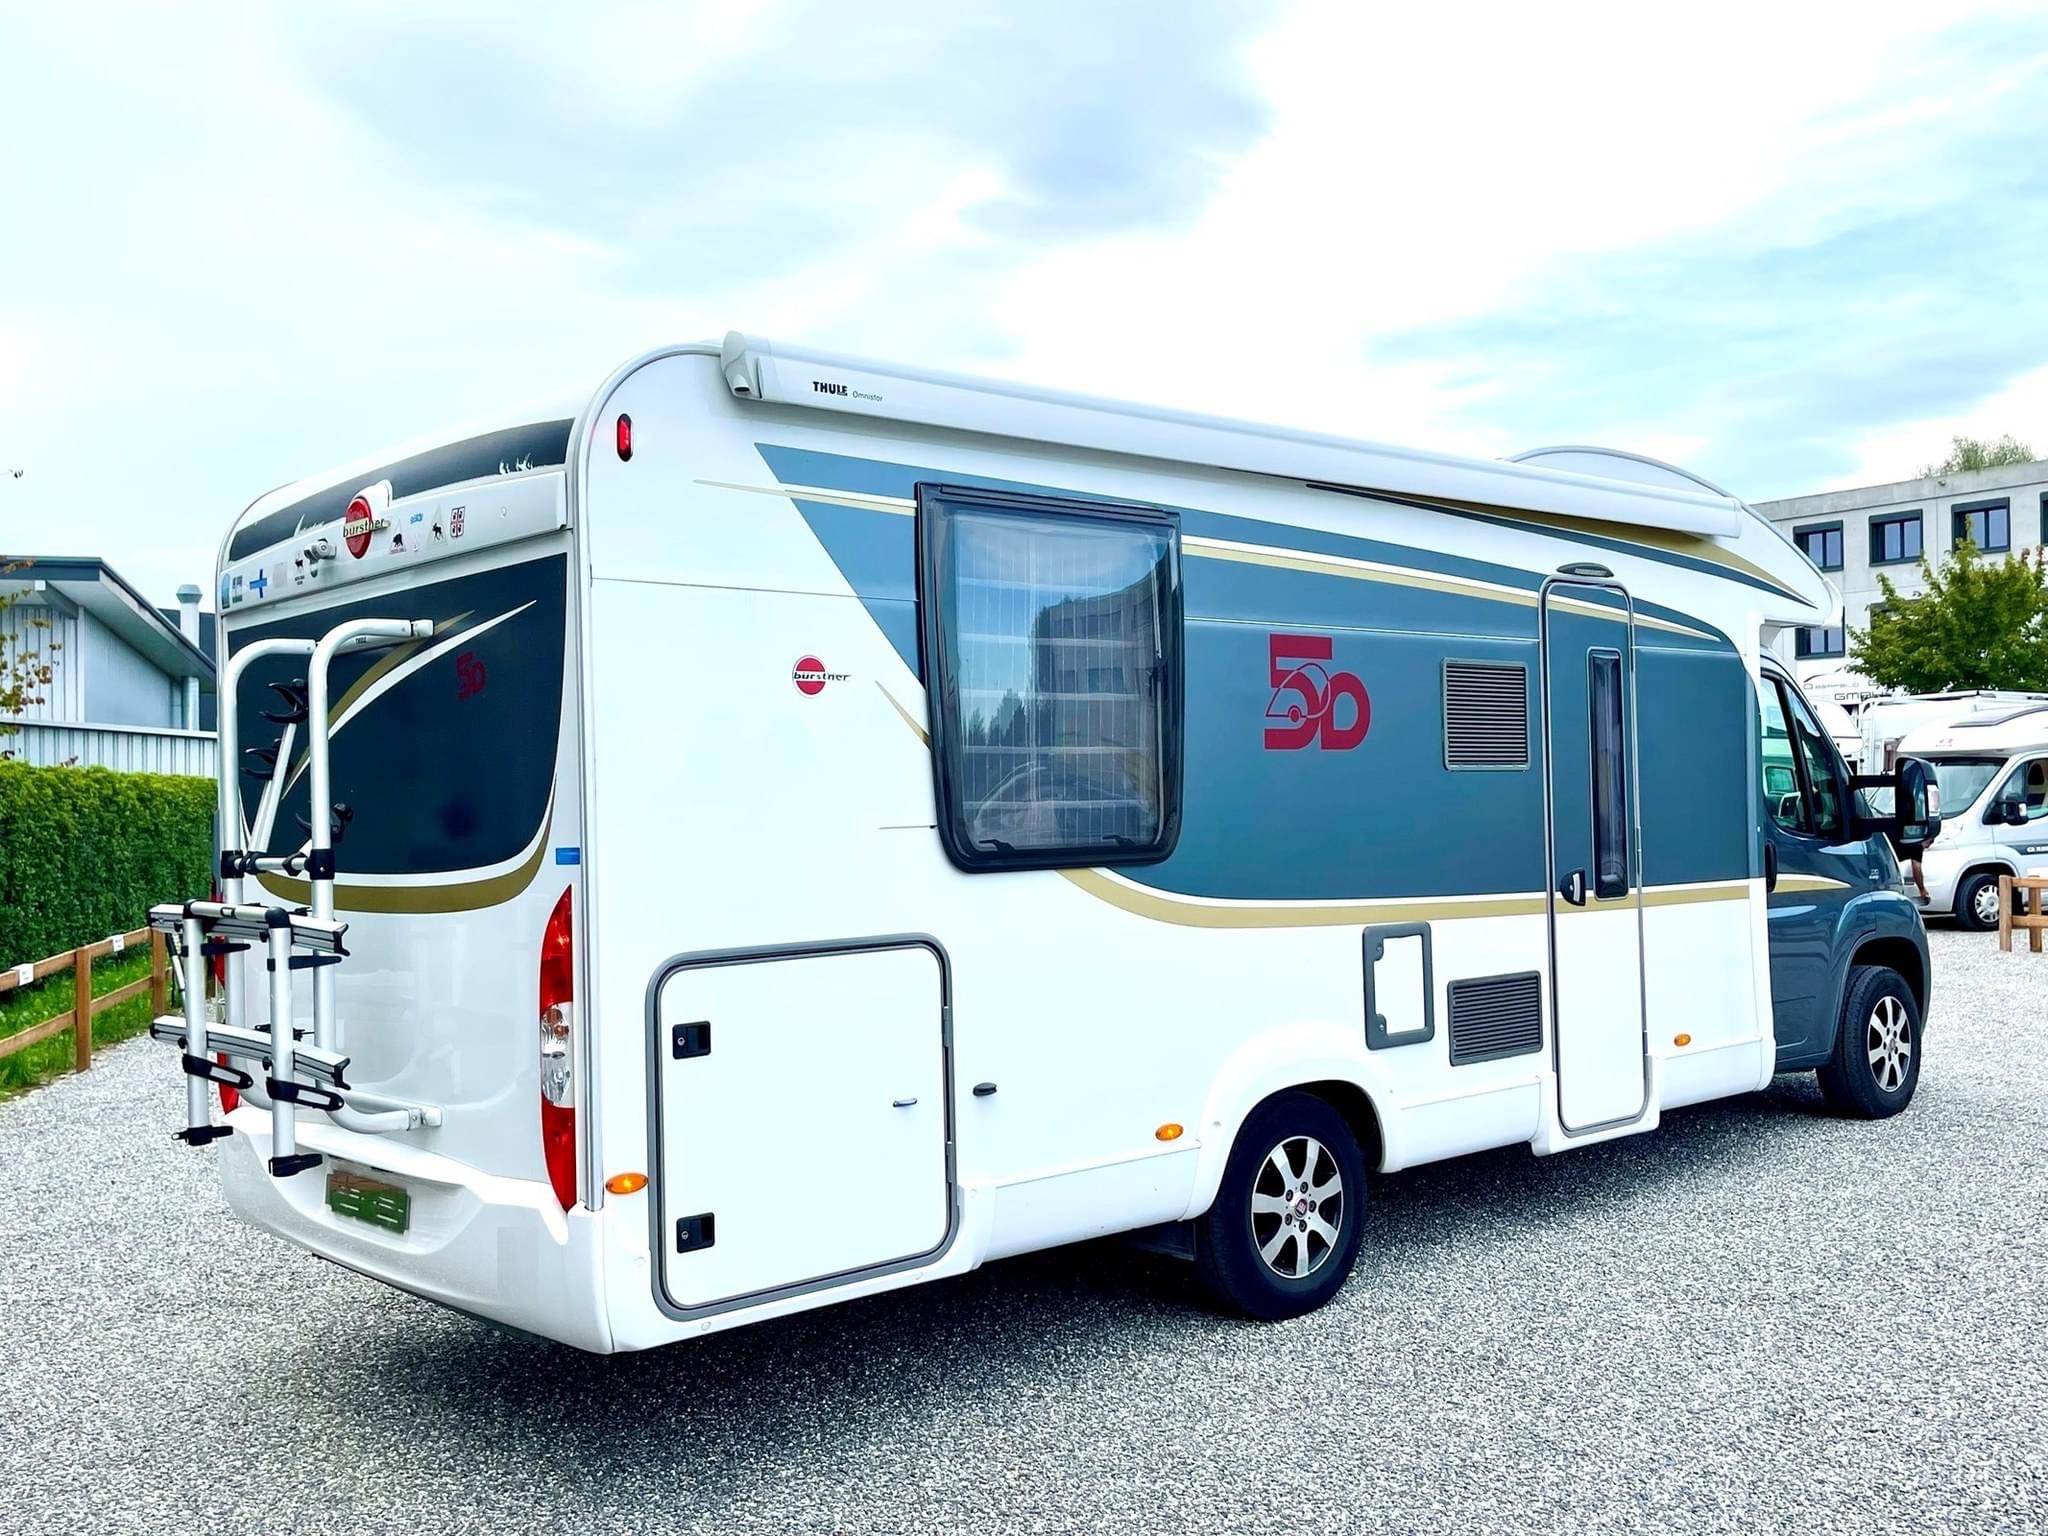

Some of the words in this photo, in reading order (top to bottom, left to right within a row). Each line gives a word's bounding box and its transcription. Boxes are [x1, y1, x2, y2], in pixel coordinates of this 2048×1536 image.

[813, 381, 848, 396] THULE
[852, 390, 883, 402] Omnistor
[1264, 633, 1371, 750] 50
